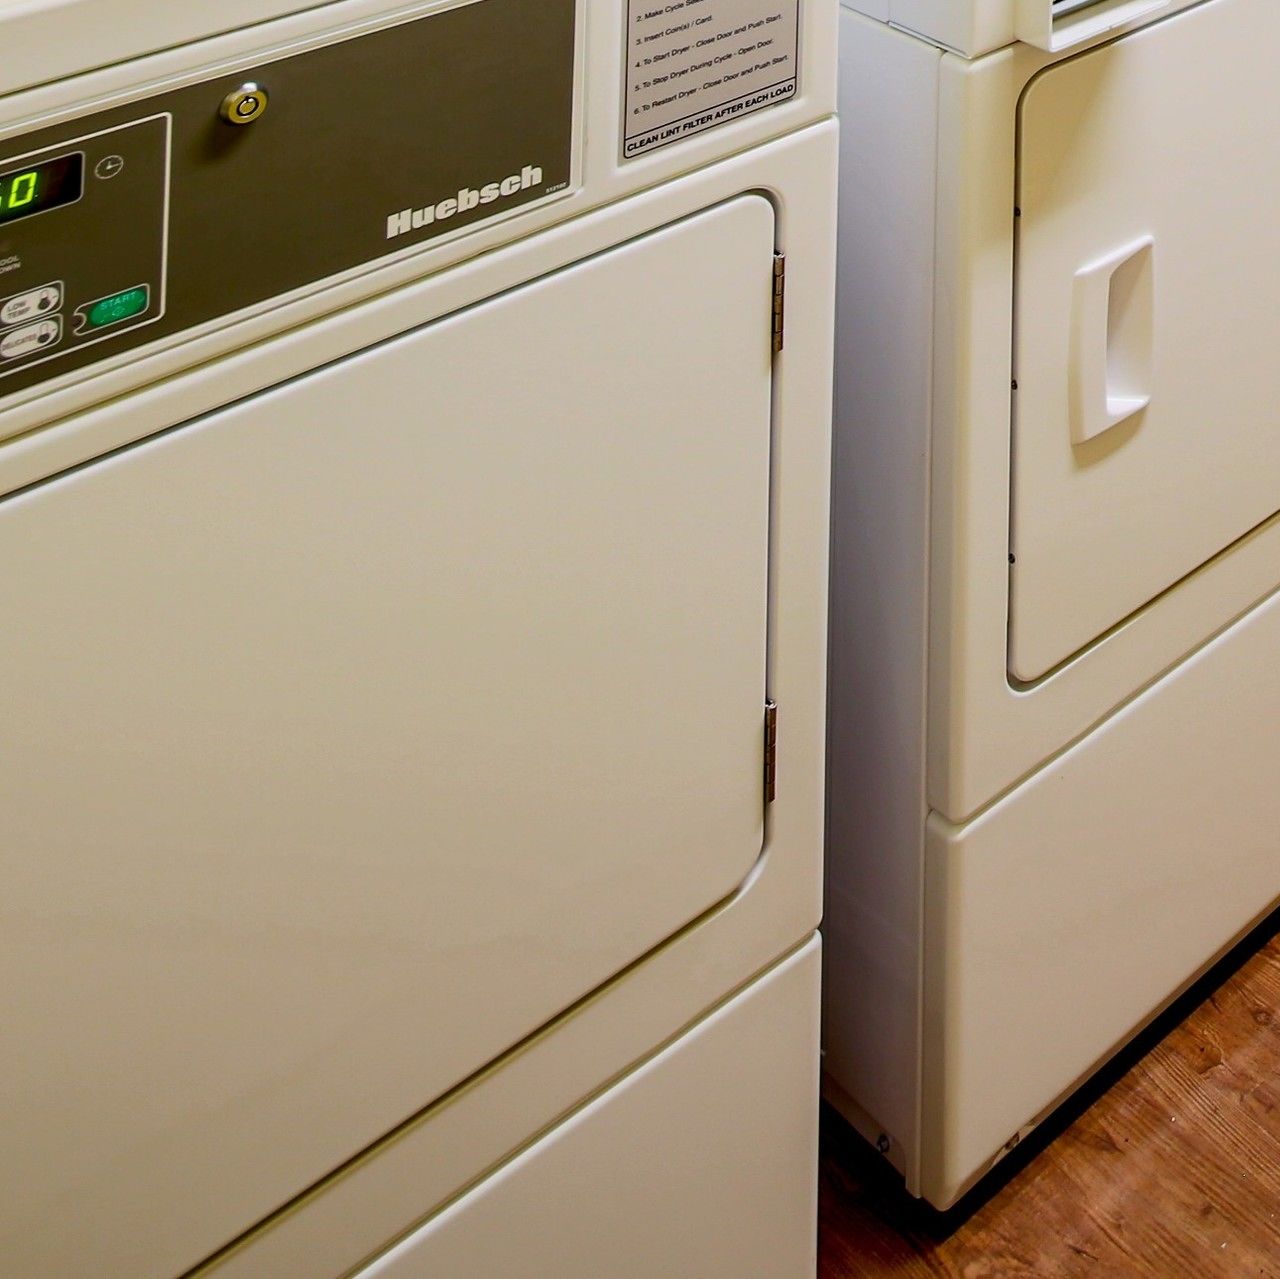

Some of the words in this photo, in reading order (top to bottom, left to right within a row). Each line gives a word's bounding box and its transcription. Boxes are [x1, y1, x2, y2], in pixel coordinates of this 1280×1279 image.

[644, 8, 663, 20] Make
[664, 1, 685, 14] Cycle
[643, 58, 652, 66] To
[653, 50, 670, 63] Start
[671, 45, 690, 58] Dryer
[695, 36, 716, 48] Close
[716, 30, 733, 41] Door
[733, 25, 747, 36] and
[748, 19, 765, 31] Push
[644, 31, 664, 43] Insert
[665, 20, 690, 37] Coin(s)
[643, 81, 651, 89] To
[653, 74, 668, 87] Stop
[670, 68, 690, 80] Dryer
[690, 60, 713, 73] During
[713, 52, 733, 65] Cycle
[738, 45, 756, 56] Open
[642, 104, 650, 112] To
[651, 94, 677, 108] Restart
[678, 88, 697, 100] Dryer
[702, 79, 722, 90] Close
[723, 72, 740, 82] Door
[741, 66, 753, 77] and
[754, 61, 771, 71] Push
[627, 134, 659, 152] CLEAN
[660, 125, 681, 140] LINT
[682, 114, 713, 132] FILTER
[714, 103, 744, 119] AFTER
[745, 93, 769, 108] EACH
[770, 84, 794, 99] LOAD
[387, 165, 543, 239] Huebsch
[7, 300, 27, 312] LOW
[7, 306, 31, 320] TEMP
[100, 291, 138, 310] START
